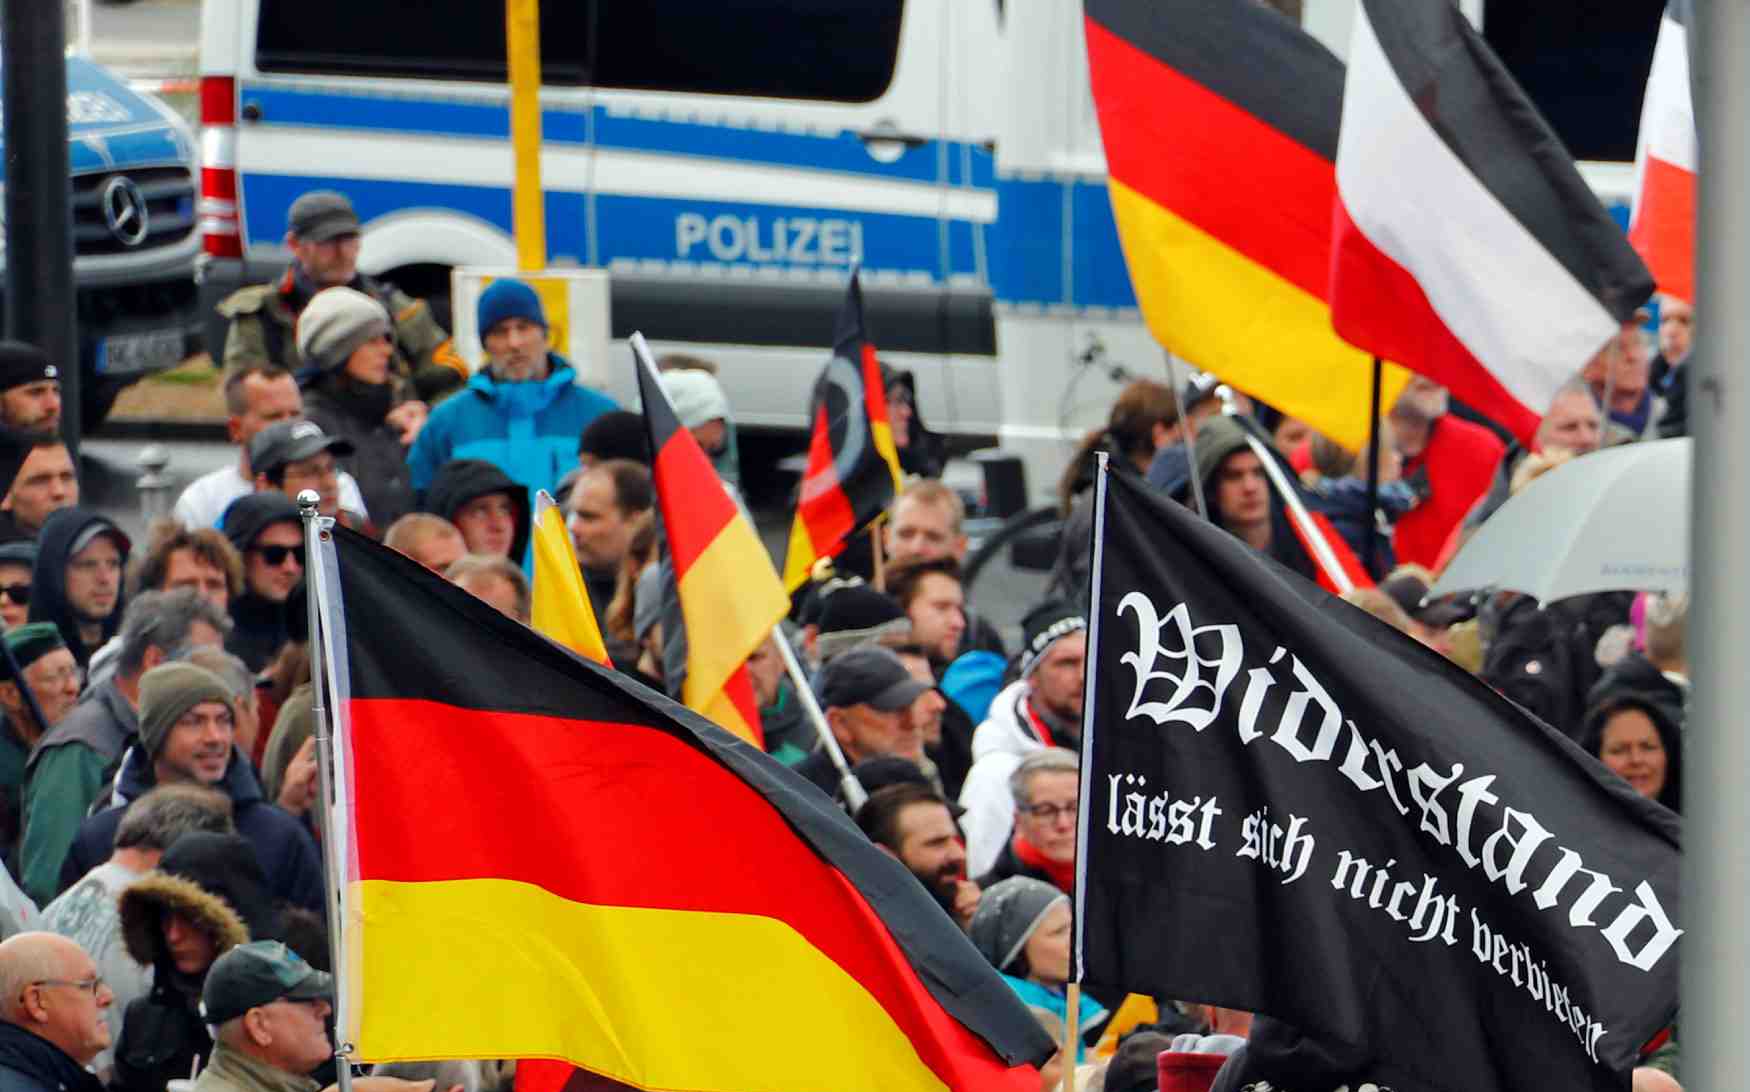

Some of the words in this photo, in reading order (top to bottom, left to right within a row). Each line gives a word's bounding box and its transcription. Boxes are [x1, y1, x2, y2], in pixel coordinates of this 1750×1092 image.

[675, 212, 864, 262] POLIZEI
[1106, 773, 1223, 850] lässt
[1236, 806, 1316, 884] sich
[1331, 849, 1461, 945] nicht
[1471, 907, 1608, 1064] verbieten
